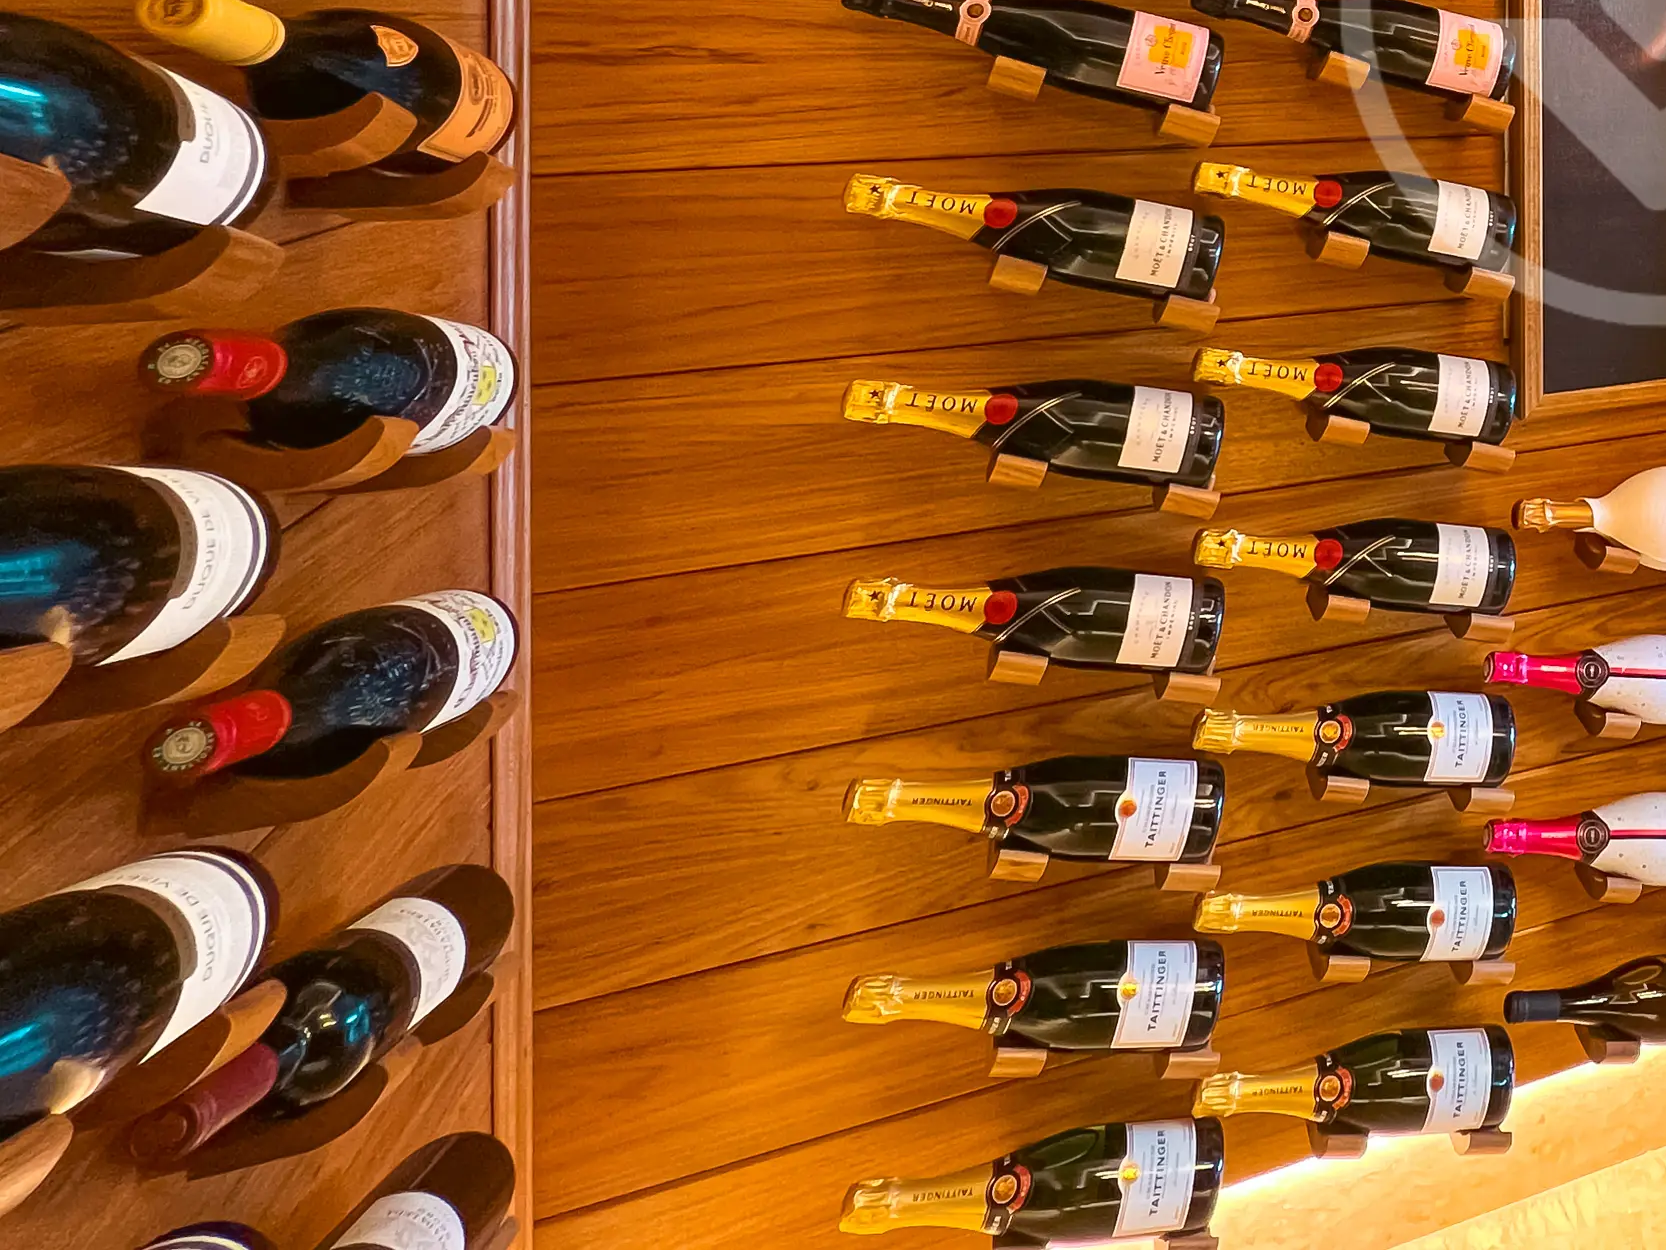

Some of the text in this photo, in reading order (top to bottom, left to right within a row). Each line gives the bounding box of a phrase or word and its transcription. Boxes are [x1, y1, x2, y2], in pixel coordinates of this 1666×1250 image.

[1253, 721, 1305, 733] TAITTINGER
[1455, 699, 1469, 768] TAITTINGER
[911, 797, 973, 806] TAITTINGER
[1144, 770, 1167, 848] TAITTINGER
[1252, 908, 1303, 918] TAITTINGER
[1451, 880, 1467, 952] TAITTINGER
[913, 989, 975, 999] TAITTINGER
[1147, 950, 1166, 1031] TAITTINGER
[1251, 1085, 1303, 1097] TAITTINGER
[1453, 1041, 1464, 1118] TAITTINGER
[1149, 1129, 1166, 1216] TAITTINGER
[912, 1189, 973, 1203] TAITTINGER
